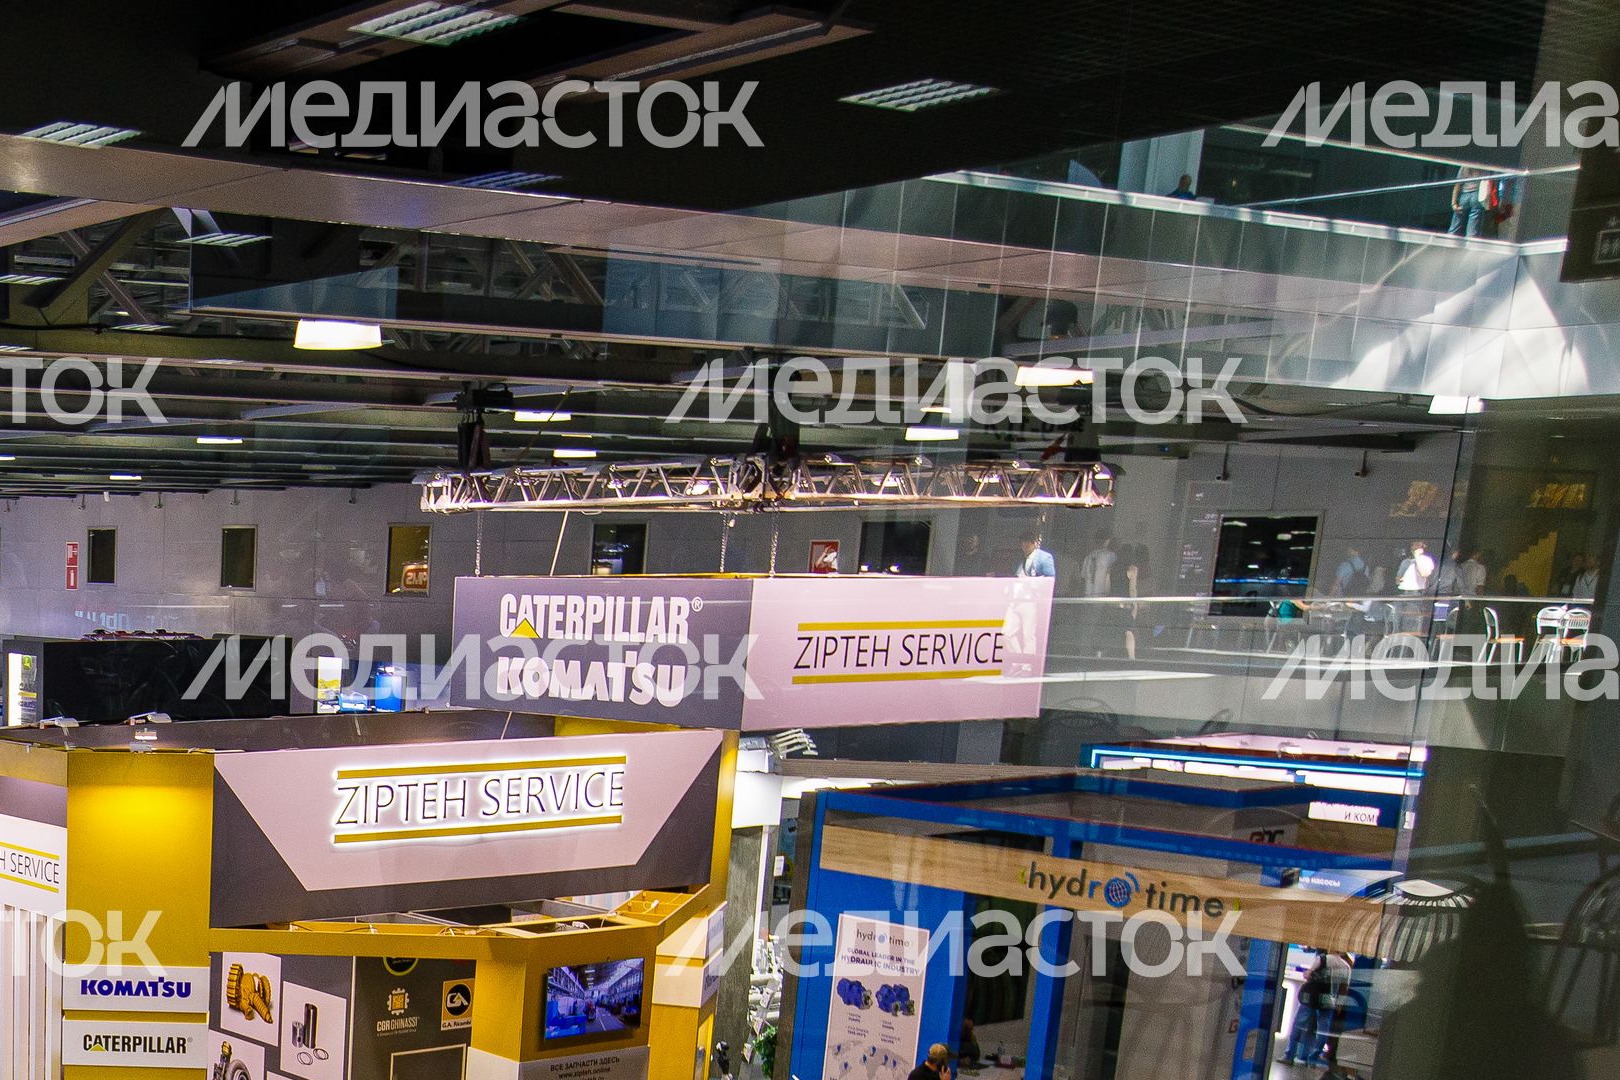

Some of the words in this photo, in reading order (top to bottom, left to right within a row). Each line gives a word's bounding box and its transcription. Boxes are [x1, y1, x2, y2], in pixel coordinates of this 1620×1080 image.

[793, 634, 890, 669] ZIPTEH
[900, 632, 1004, 666] SERVICE
[496, 650, 686, 708] KOMATSU
[335, 780, 466, 826] ZIPTEH
[481, 770, 626, 816] SERVICE
[10, 852, 60, 885] SERVICE
[1145, 881, 1224, 917] time
[840, 954, 882, 969] HYDRAULIC
[882, 963, 920, 975] INDUSTRY
[847, 947, 870, 958] GLOBAL
[871, 951, 894, 962] LEADER
[903, 957, 916, 965] THE
[80, 976, 191, 998] KOMATSU
[550, 1064, 563, 1072] ВСЕ
[565, 1058, 598, 1069] ЗАПЧАСТИ
